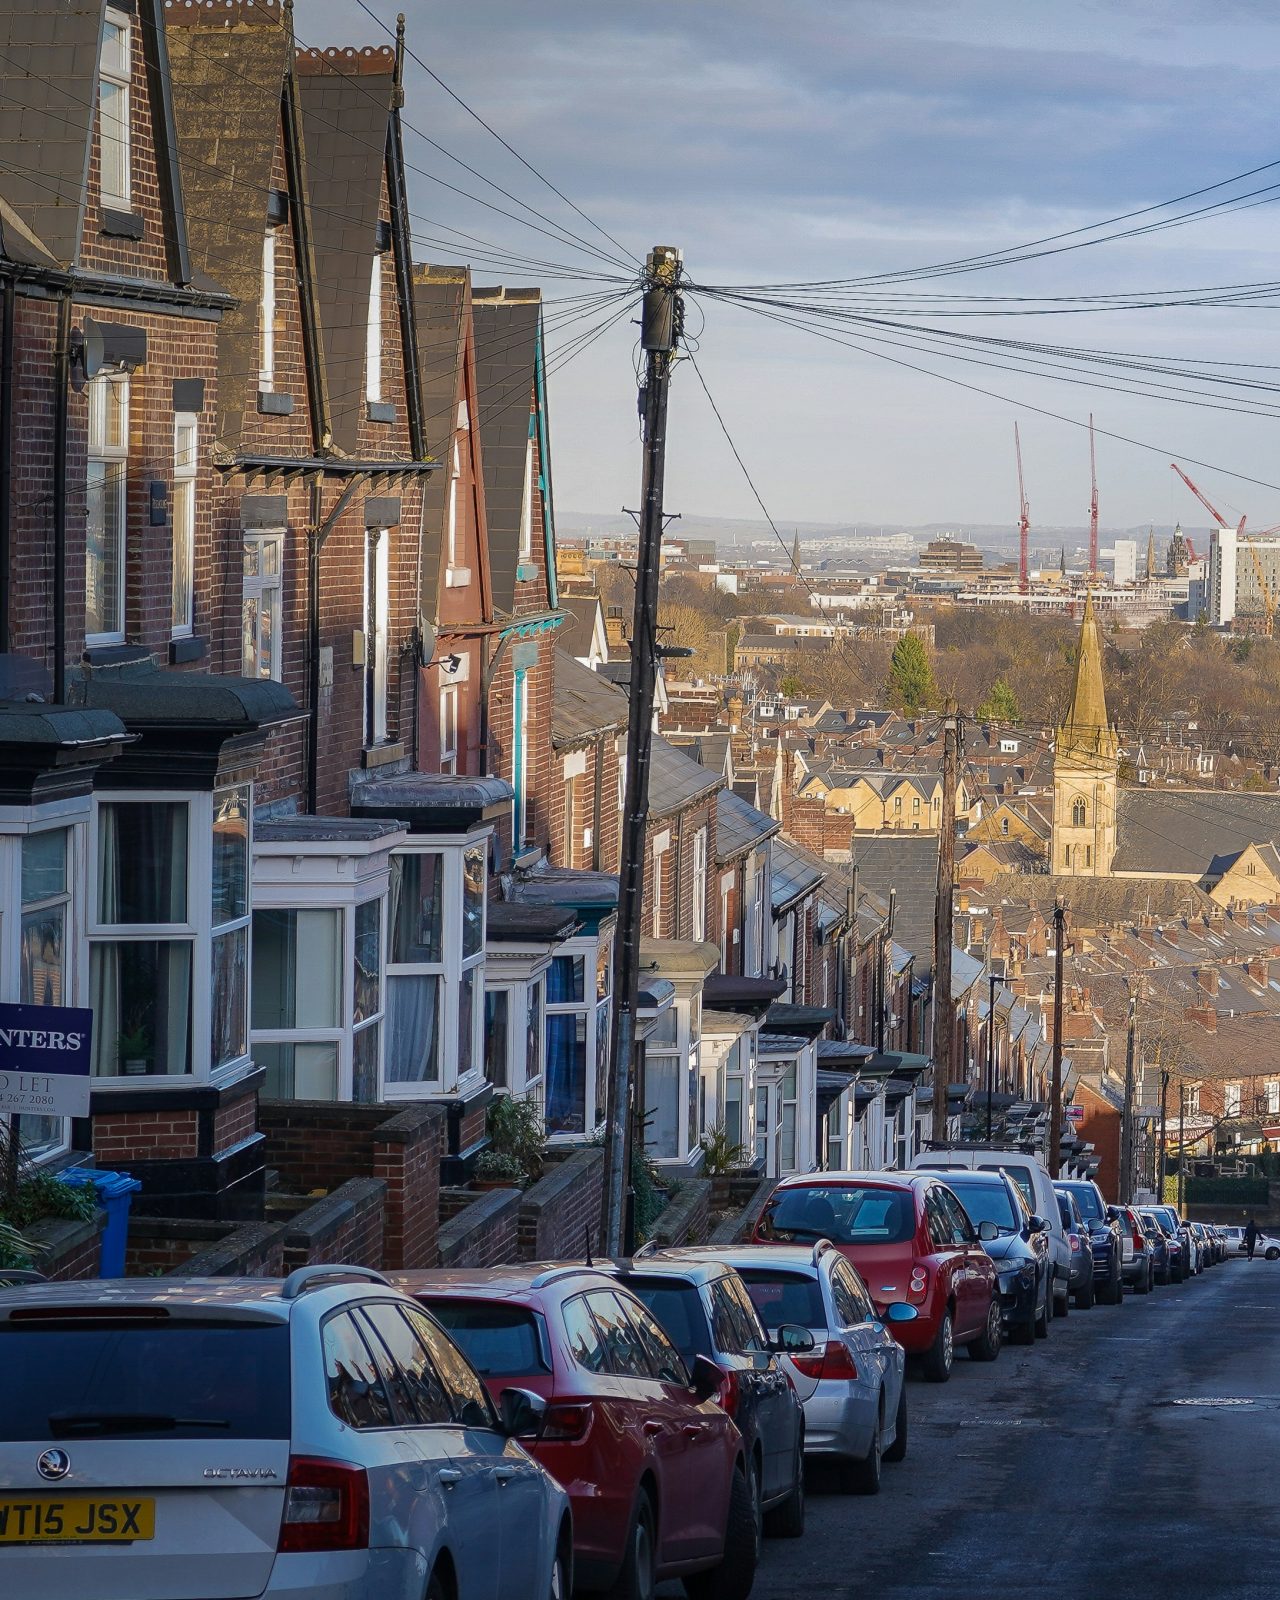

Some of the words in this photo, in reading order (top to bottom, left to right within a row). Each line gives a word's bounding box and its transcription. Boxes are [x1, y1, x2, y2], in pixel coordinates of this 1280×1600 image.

[20, 1076, 55, 1093] LET
[7, 1093, 26, 1103] 267
[29, 1095, 54, 1105] 2080
[203, 1467, 278, 1479] OCTAVIA
[75, 1503, 142, 1535] JSX
